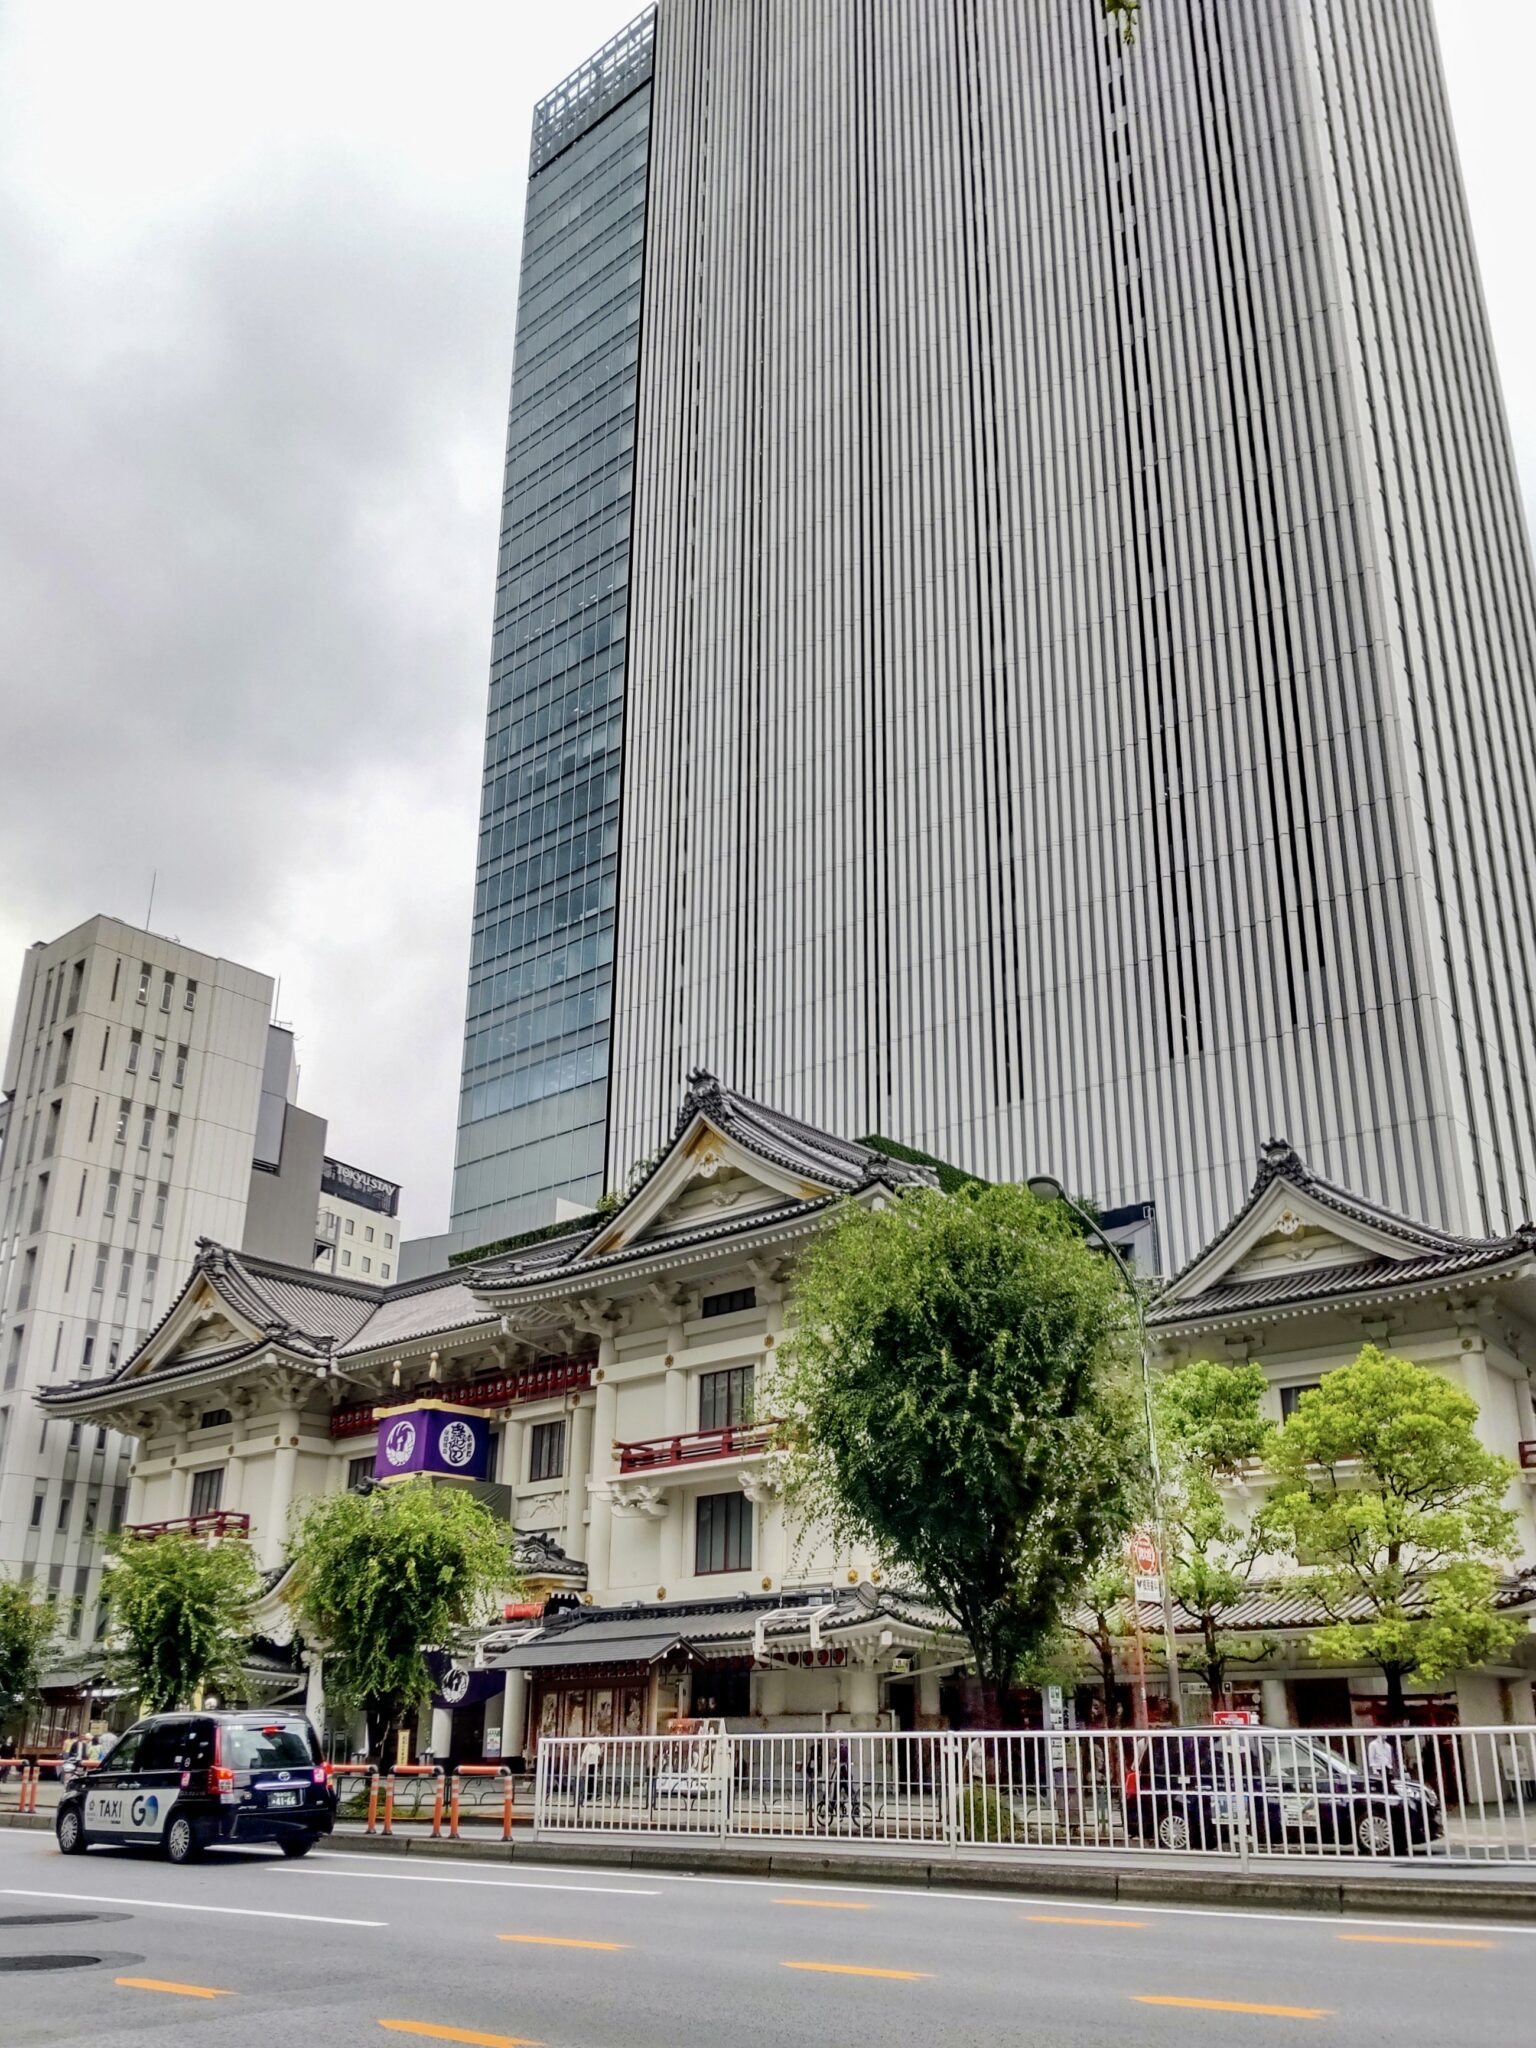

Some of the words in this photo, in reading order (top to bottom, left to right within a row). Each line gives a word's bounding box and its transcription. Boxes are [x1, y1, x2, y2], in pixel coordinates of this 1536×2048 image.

[336, 1164, 370, 1186] TOKYU
[370, 1178, 397, 1197] STAY
[99, 1799, 123, 1819] TAXI
